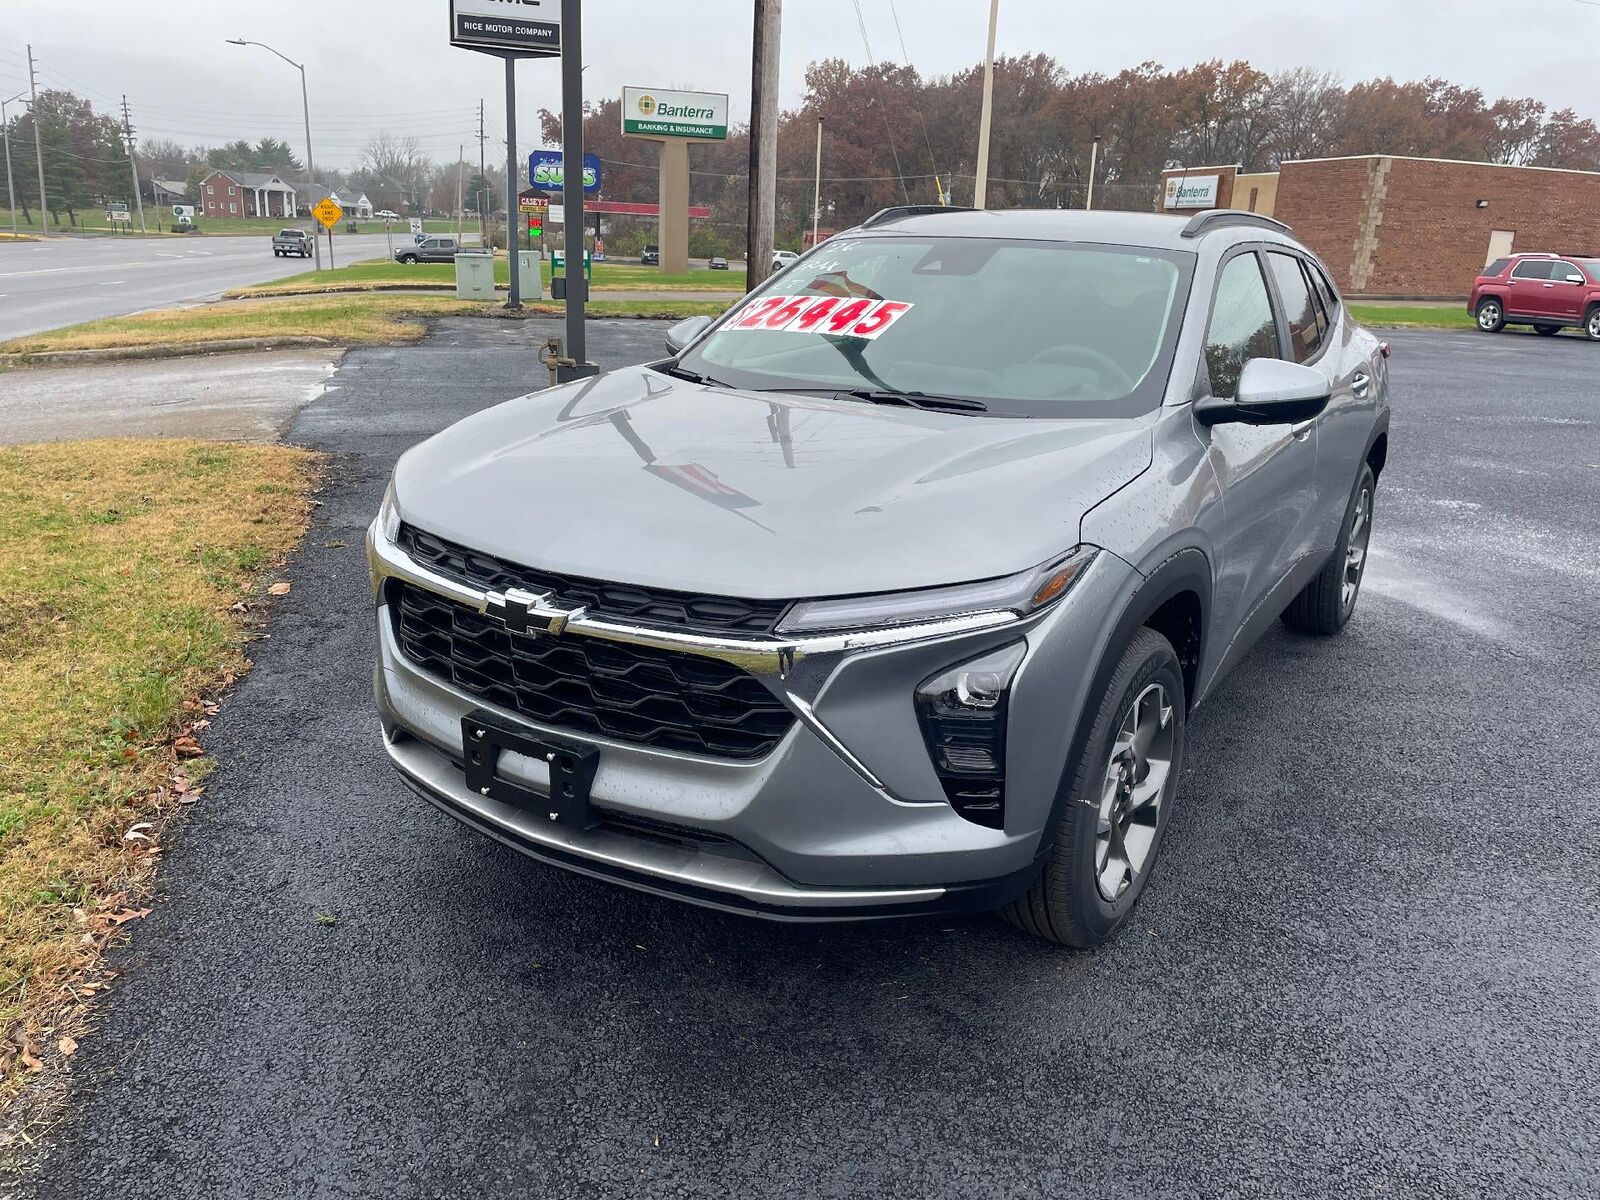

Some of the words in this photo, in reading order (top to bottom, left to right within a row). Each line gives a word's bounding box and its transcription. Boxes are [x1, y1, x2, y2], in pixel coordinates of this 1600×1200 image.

[464, 21, 483, 31] RICE
[485, 23, 513, 34] MOTOR
[515, 26, 553, 37] COMPANY
[657, 102, 714, 119] Banterra
[637, 122, 669, 132] BANKING
[675, 126, 714, 135] INSURANCE
[1176, 185, 1209, 198] Banterra
[521, 197, 549, 206] CASEY'S
[728, 296, 910, 335] $26445
